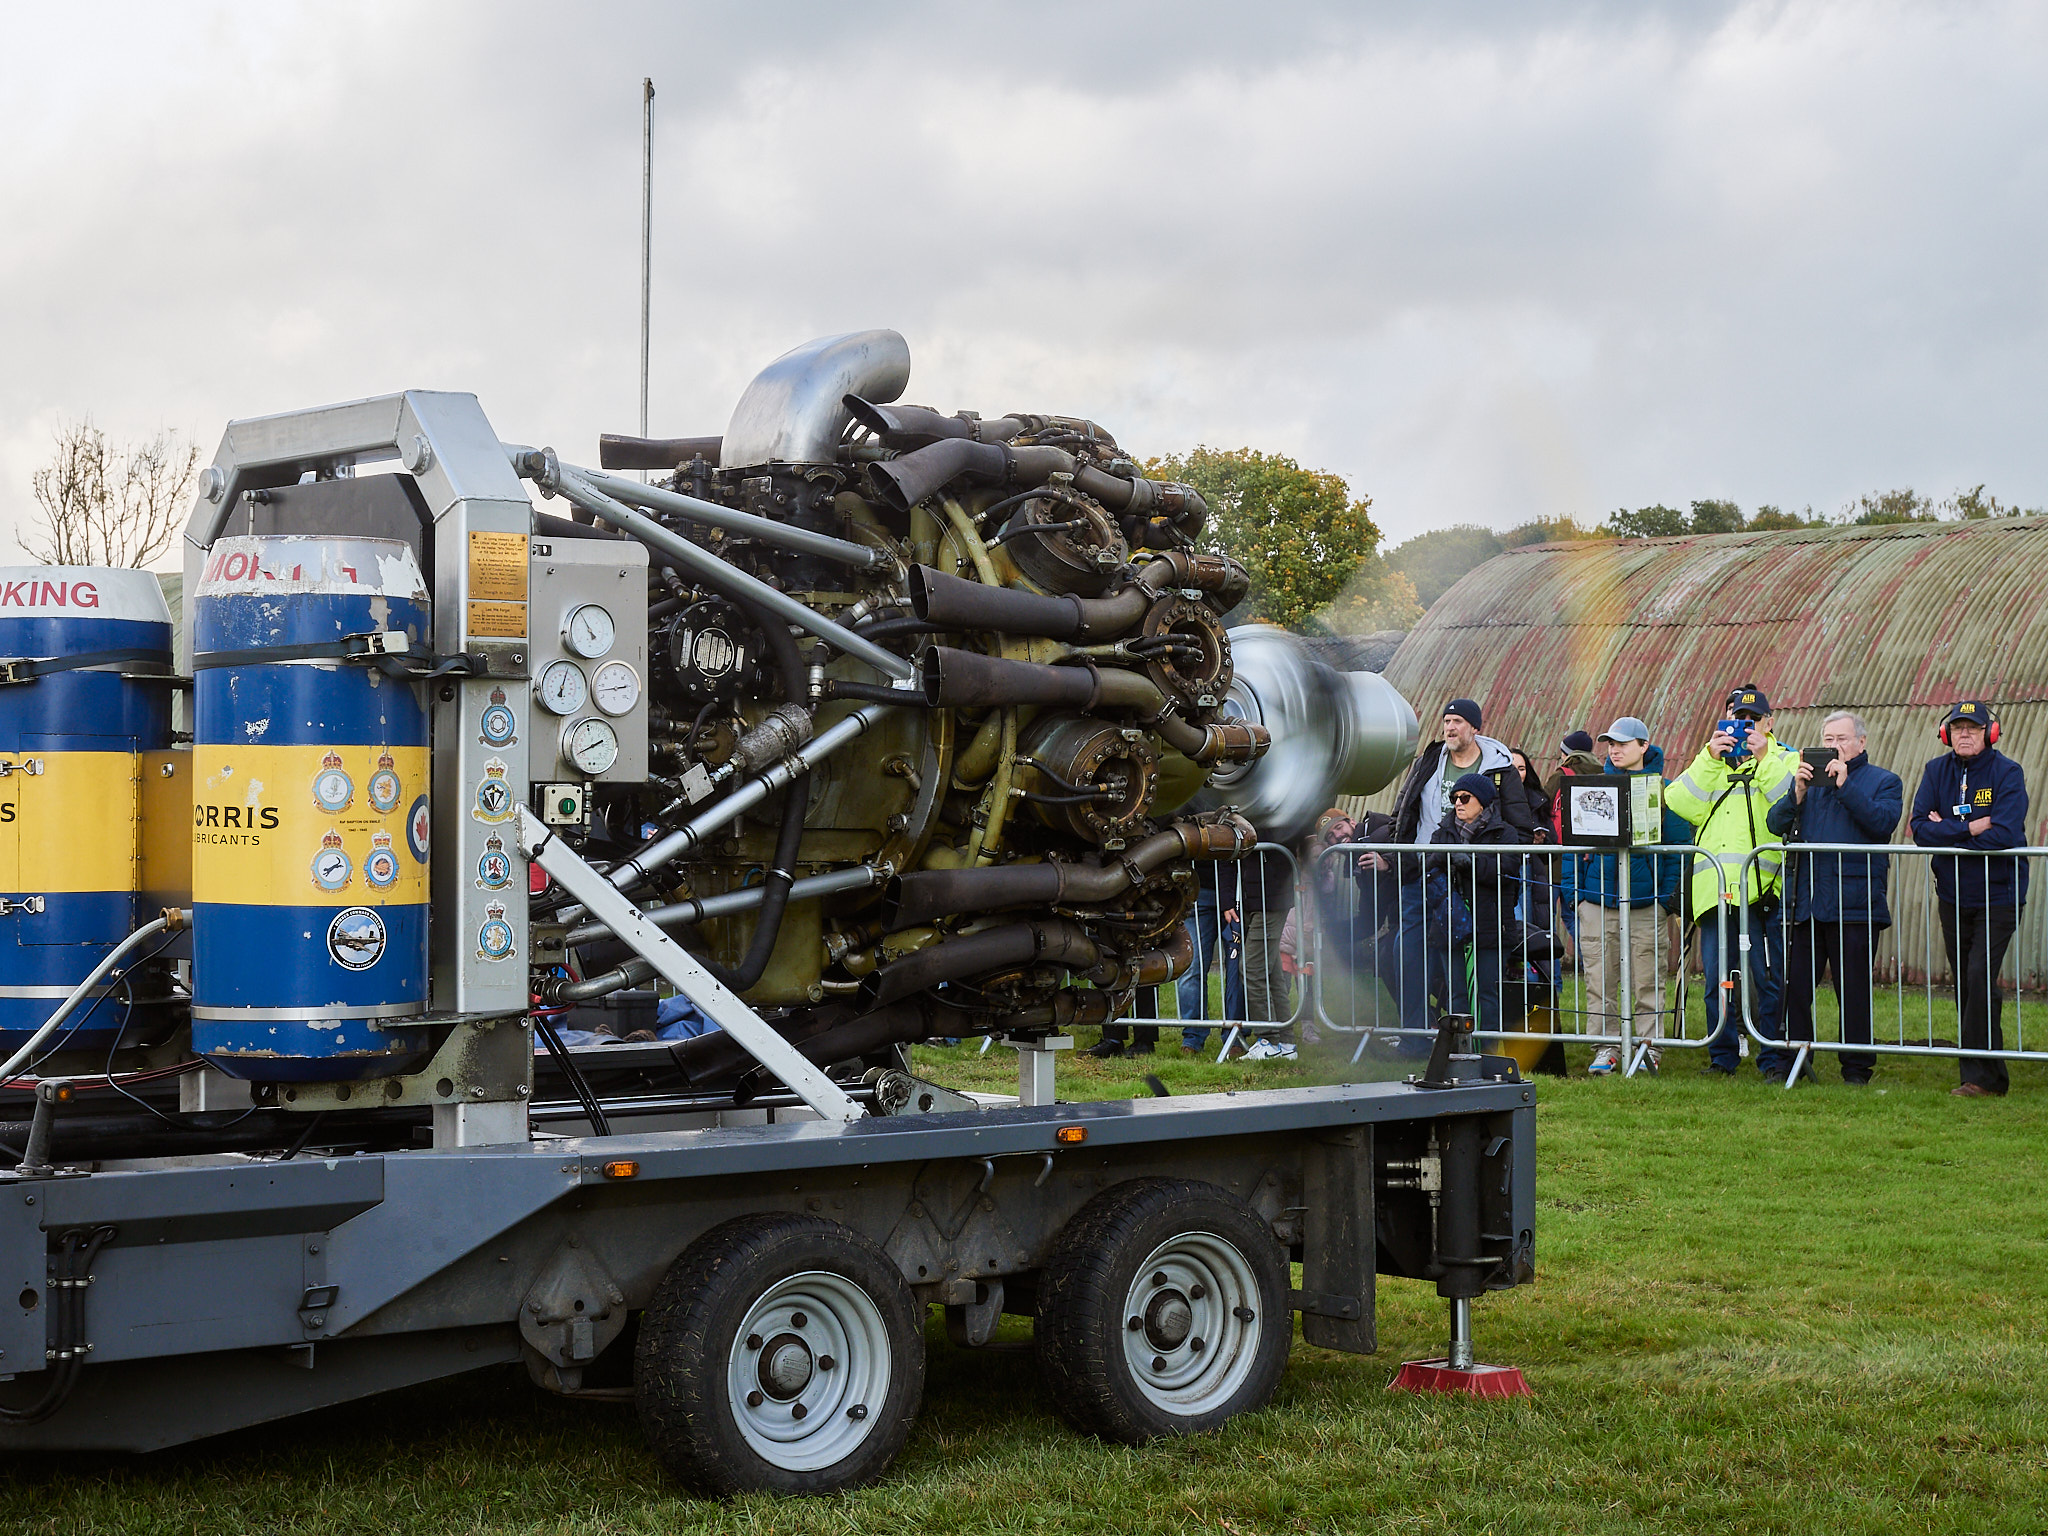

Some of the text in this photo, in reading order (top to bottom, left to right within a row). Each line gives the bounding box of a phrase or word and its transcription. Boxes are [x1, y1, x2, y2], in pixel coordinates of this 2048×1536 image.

[0, 581, 99, 608] KING
[1741, 694, 1756, 703] AIR
[1960, 703, 1976, 712] AIR
[1974, 790, 1992, 800] AIR
[193, 804, 280, 829] ORRIS
[194, 833, 260, 846] BRICANTS
